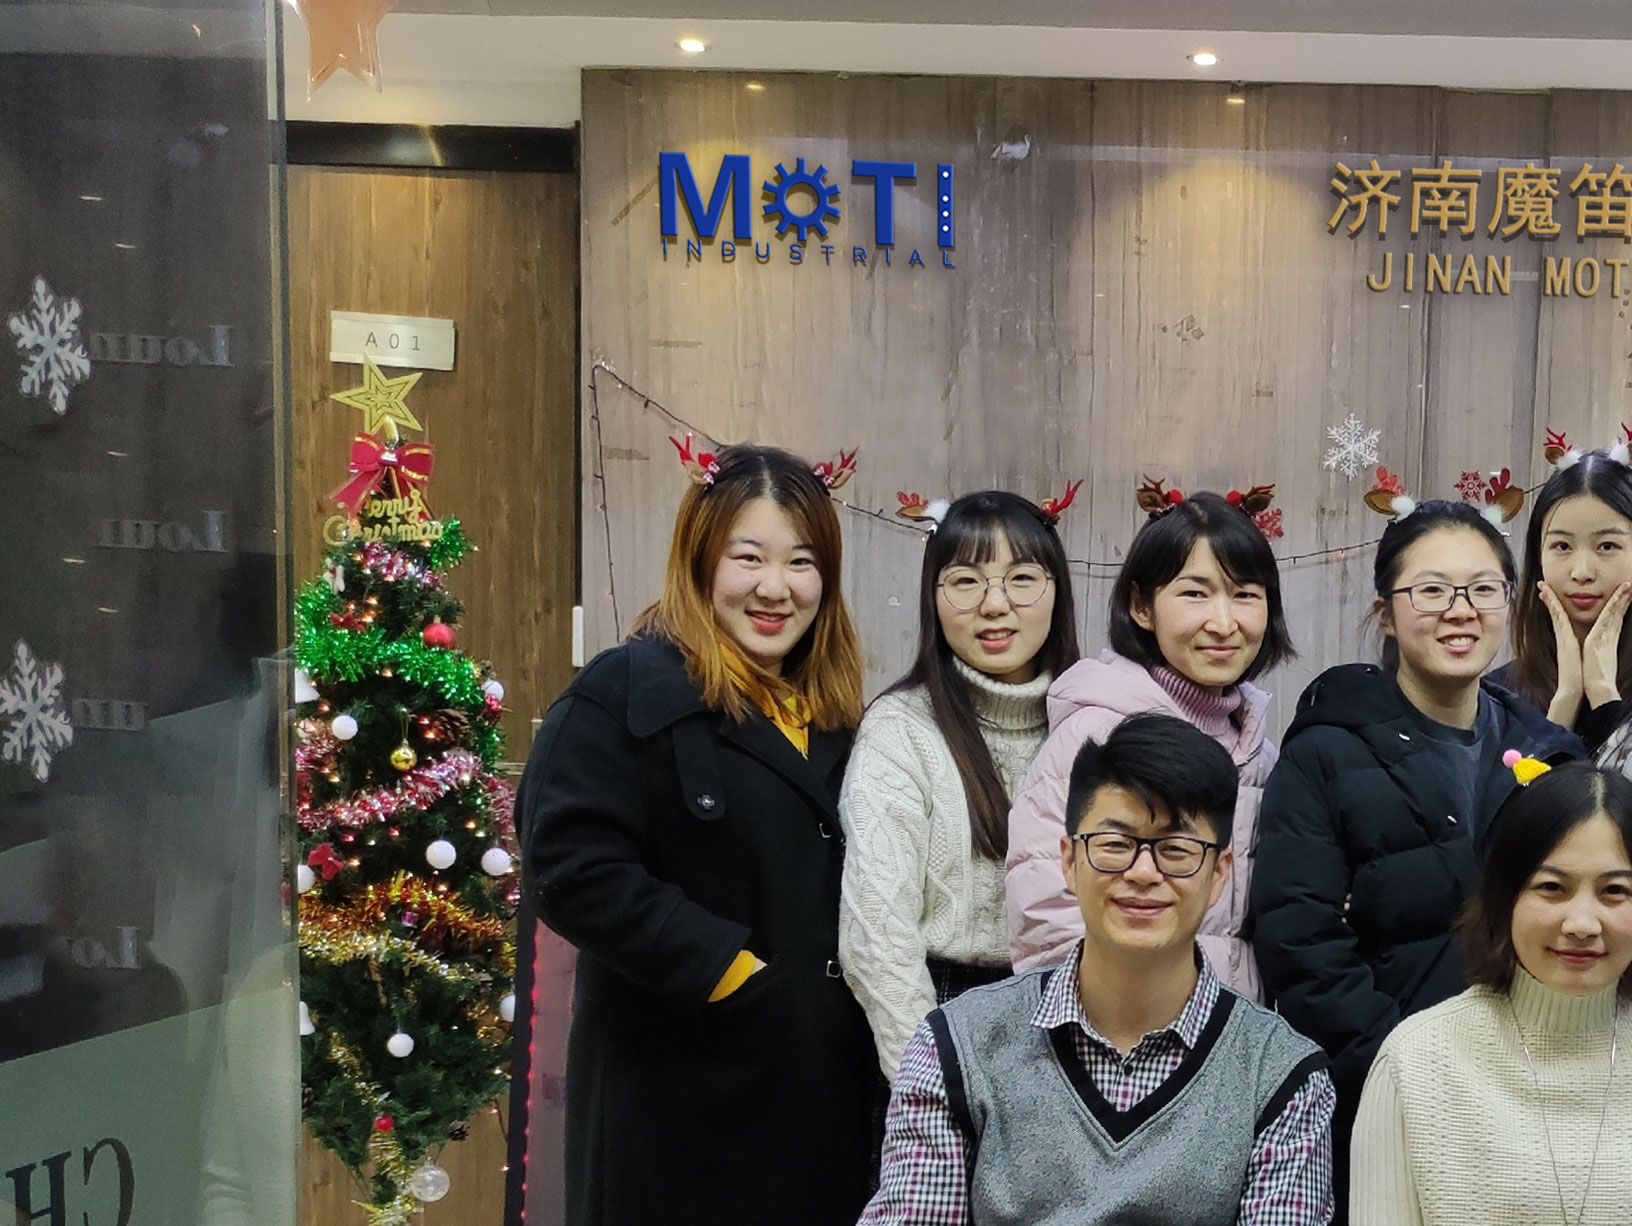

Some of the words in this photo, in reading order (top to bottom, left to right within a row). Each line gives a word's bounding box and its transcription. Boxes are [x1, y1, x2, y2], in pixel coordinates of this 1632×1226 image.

[659, 152, 954, 247] MOTI
[662, 238, 954, 267] INDUSTRIAL
[1367, 252, 1511, 295] JINAN
[364, 331, 421, 351] A01
